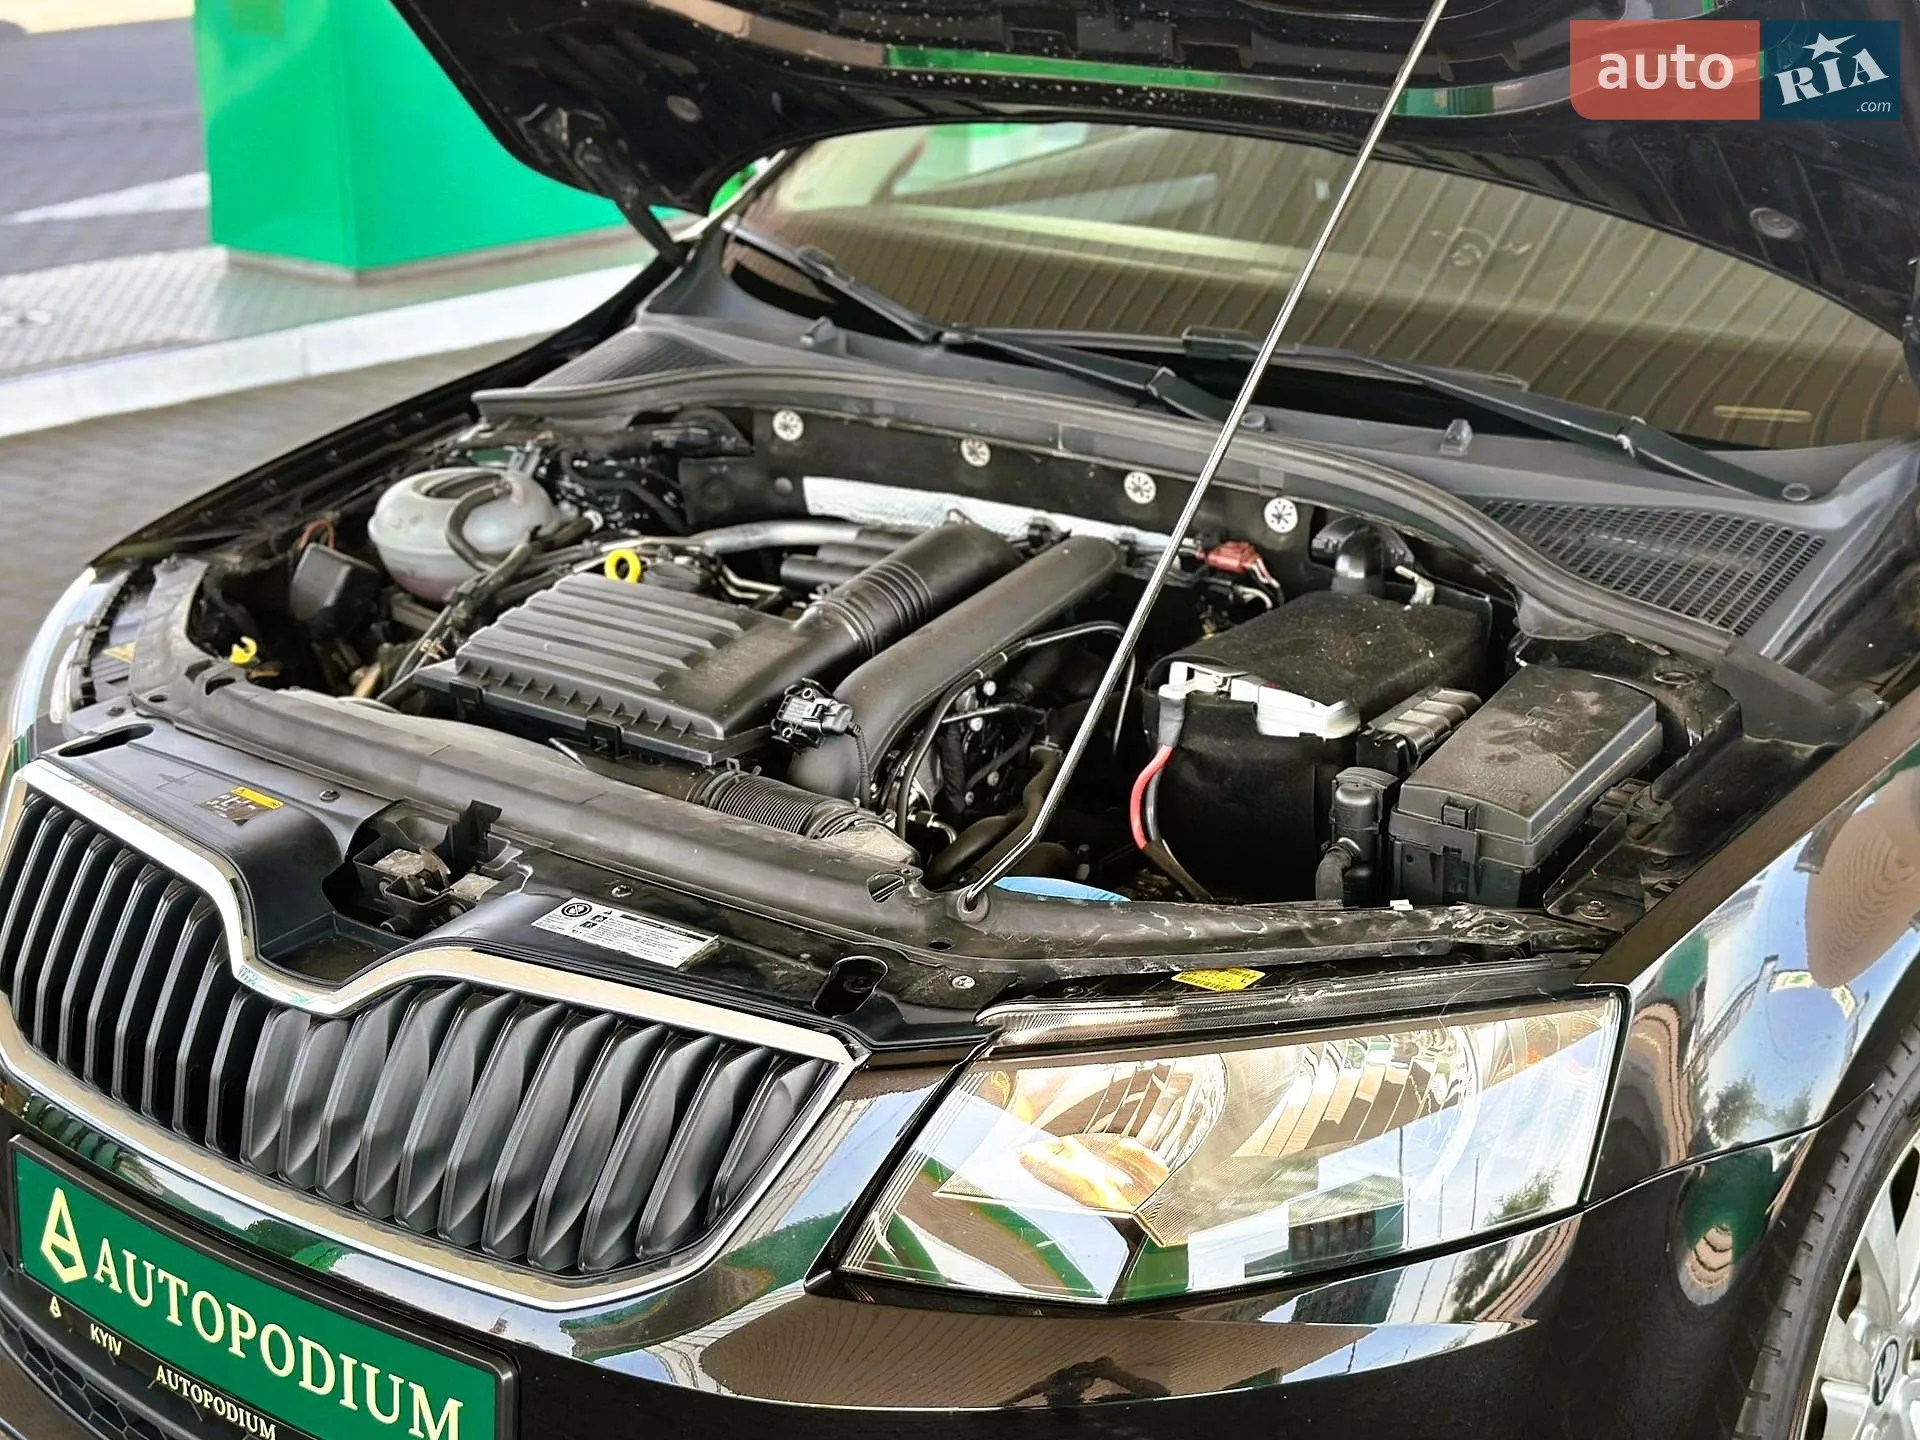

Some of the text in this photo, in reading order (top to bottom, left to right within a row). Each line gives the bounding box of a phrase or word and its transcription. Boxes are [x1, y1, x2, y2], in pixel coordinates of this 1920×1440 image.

[90, 1323, 277, 1440] KYIV AUTOPODIUM
[94, 1238, 464, 1440] AUTOPODIUM
